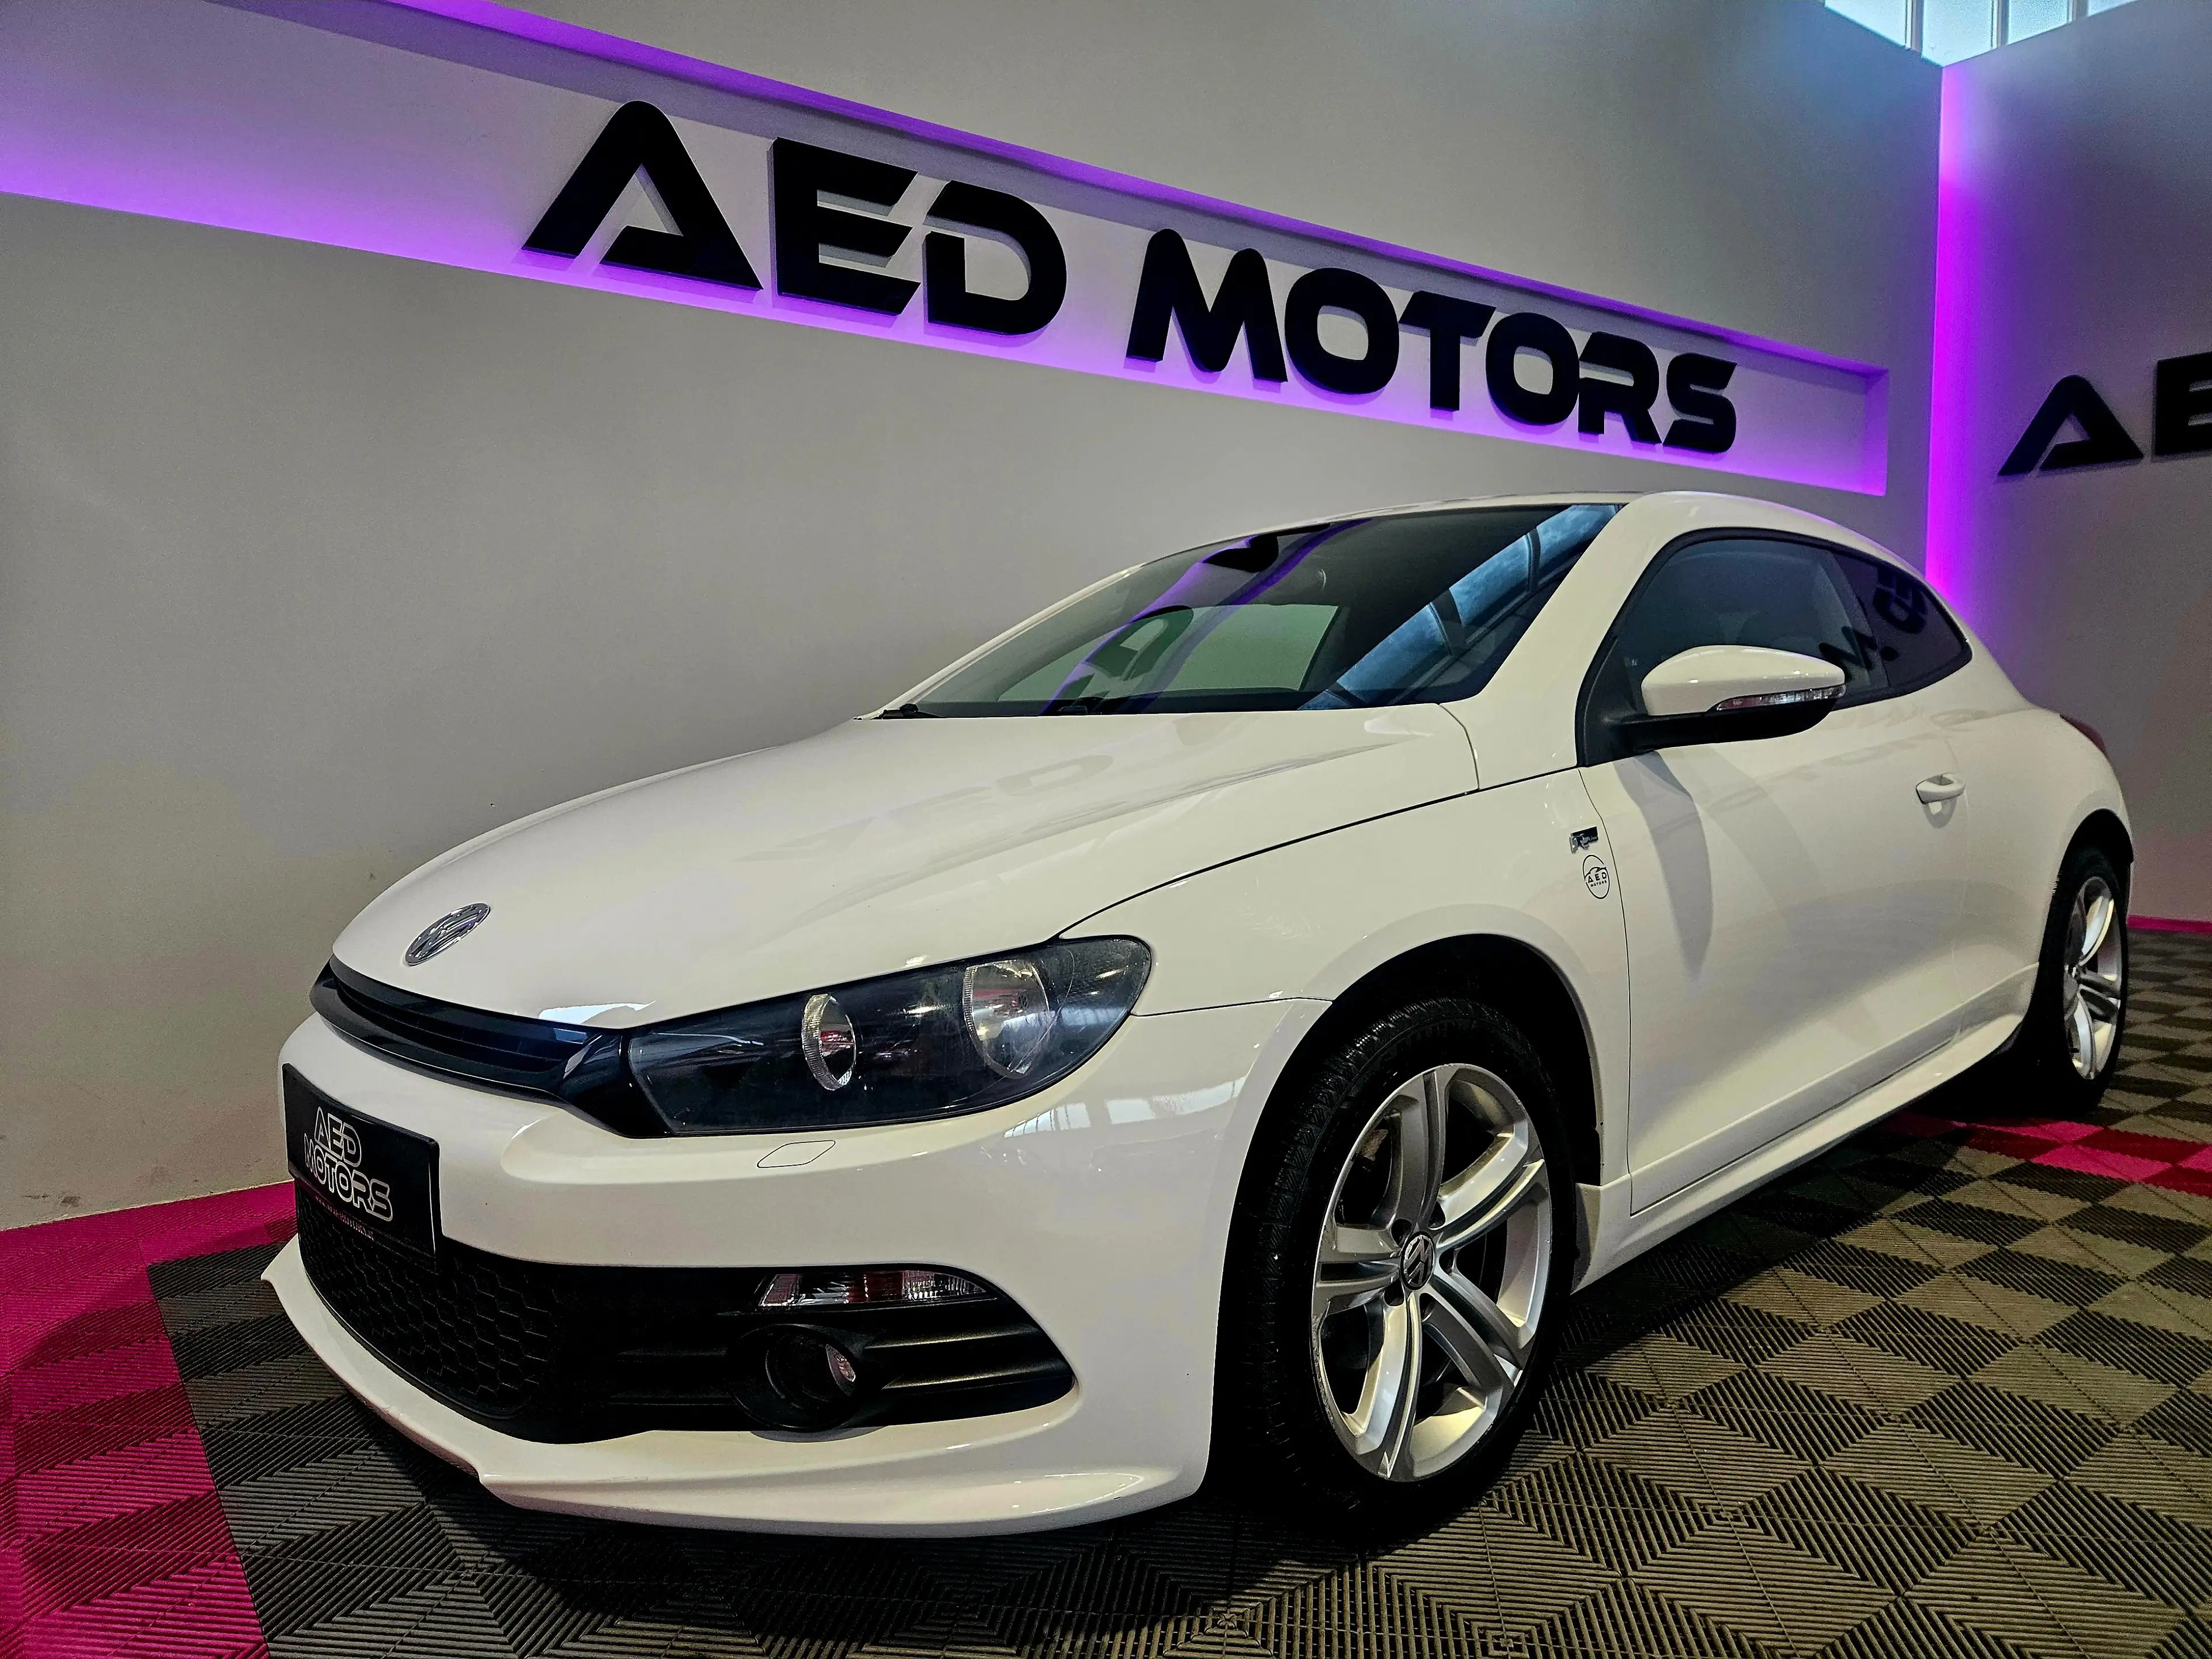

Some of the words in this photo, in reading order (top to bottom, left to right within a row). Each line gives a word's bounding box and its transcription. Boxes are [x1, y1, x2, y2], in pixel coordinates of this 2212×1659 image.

[522, 100, 1067, 336] AED
[1125, 228, 1737, 454] MOTORS
[1588, 872, 1607, 883] AED
[315, 1106, 361, 1167] AED
[304, 1132, 393, 1221] MOTORS
